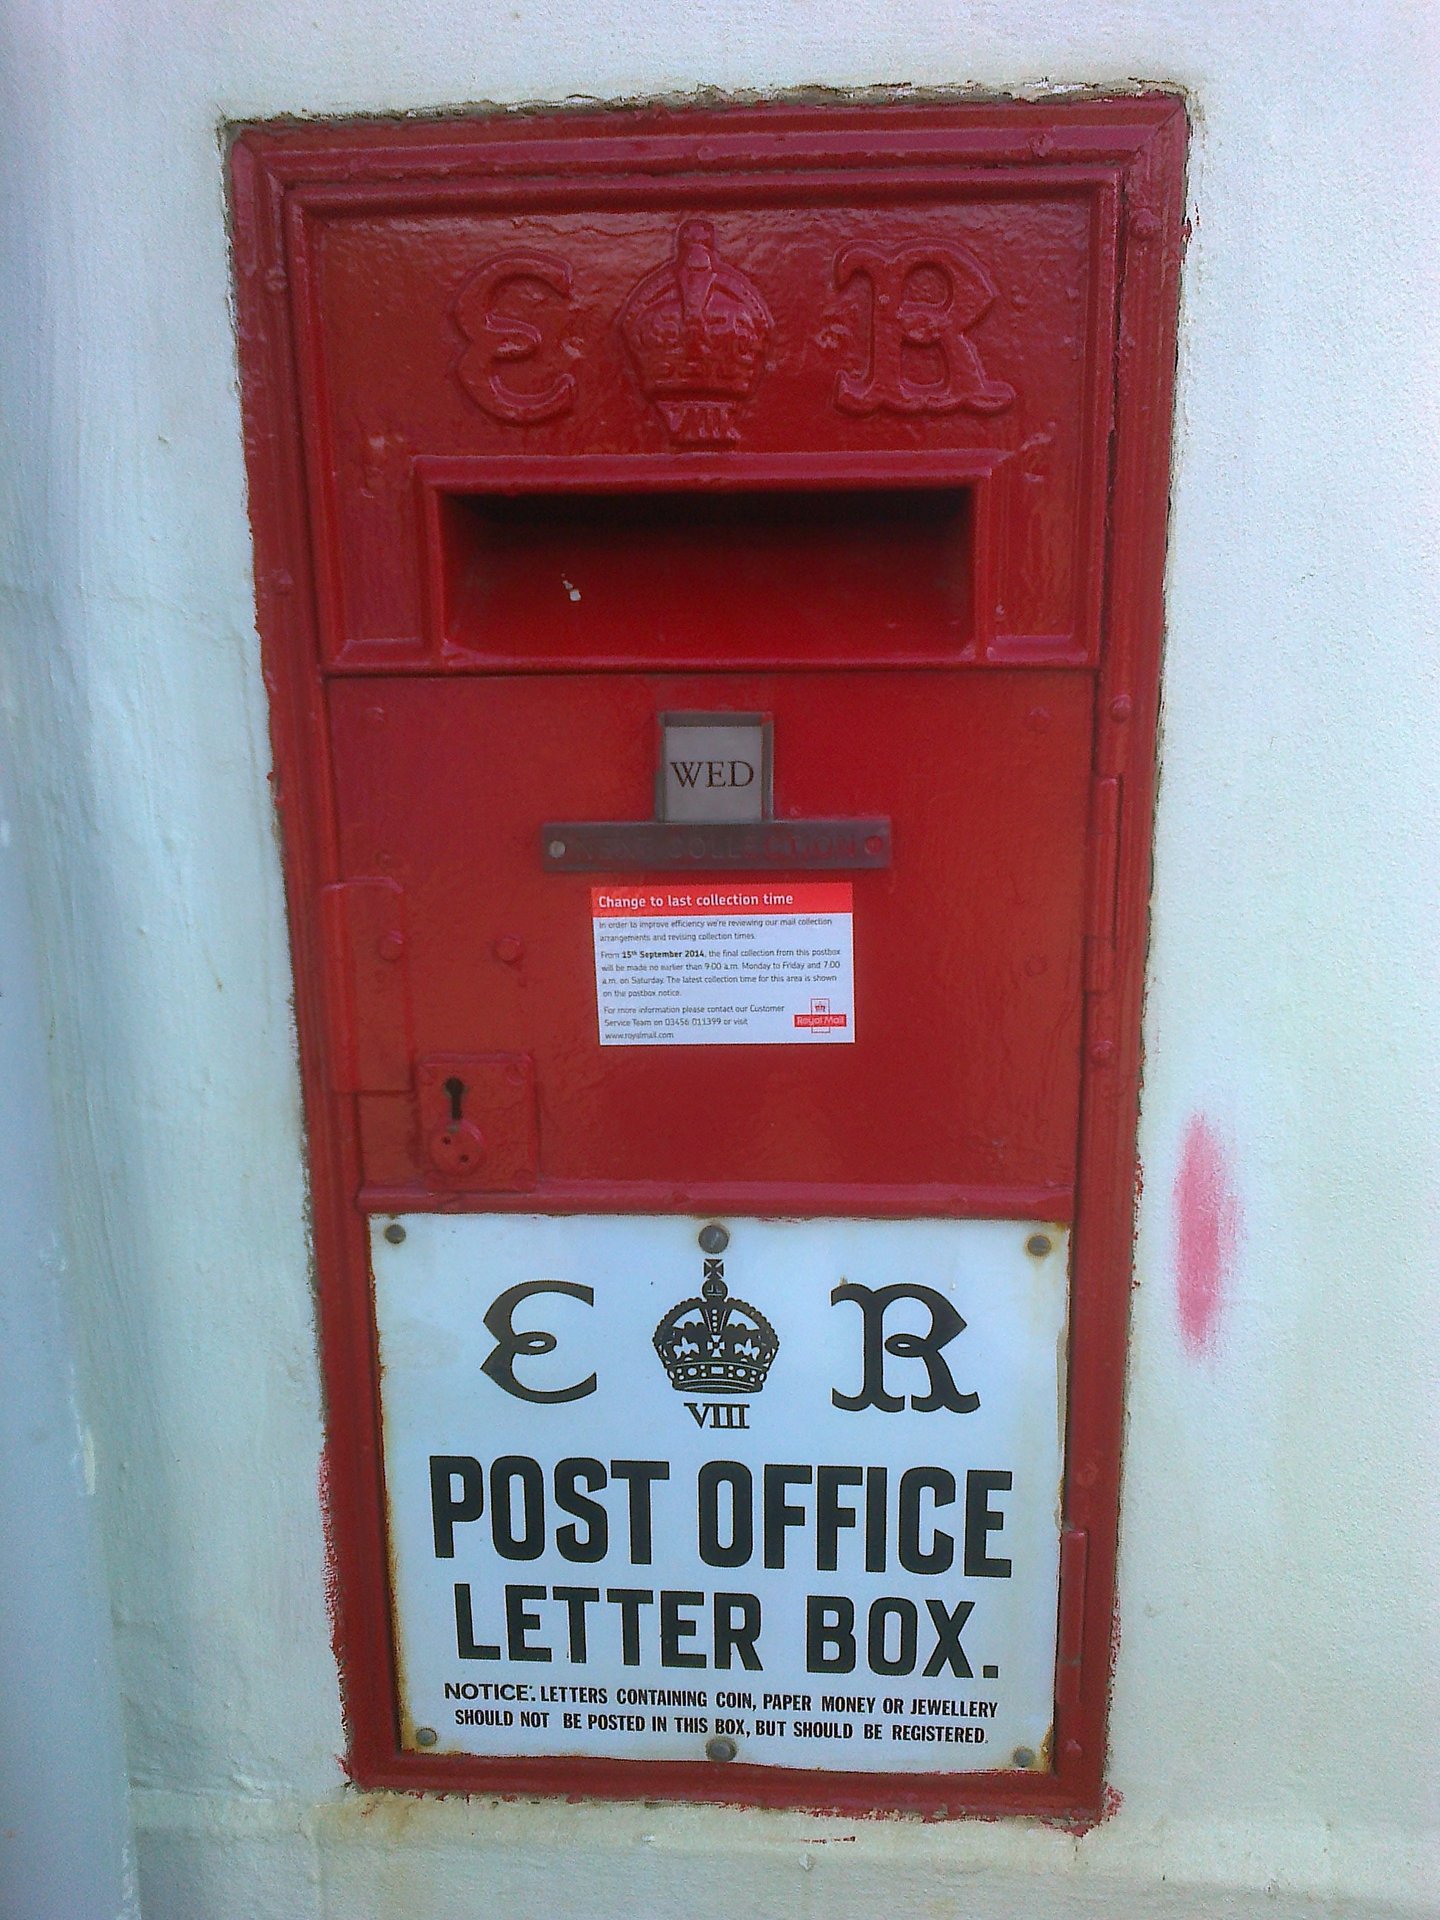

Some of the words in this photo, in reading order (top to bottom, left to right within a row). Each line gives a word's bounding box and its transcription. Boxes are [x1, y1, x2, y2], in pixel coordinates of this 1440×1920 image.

[451, 247, 574, 422] E
[833, 237, 1014, 416] R
[670, 761, 754, 788] WED
[598, 895, 646, 910] Change
[650, 896, 663, 907] to
[668, 895, 691, 907] last
[696, 893, 759, 906] collection
[763, 892, 793, 905] time
[608, 920, 627, 929] order
[630, 921, 637, 929] to
[640, 920, 669, 930] improve
[671, 919, 705, 929] efficiency
[728, 918, 763, 928] reviewing
[780, 918, 796, 926] mail
[798, 917, 832, 926] collection
[600, 934, 650, 943] arrangements
[653, 933, 666, 941] and
[668, 933, 697, 942] revising
[698, 932, 732, 941] collection
[601, 951, 619, 959] From
[640, 950, 682, 960] September
[708, 950, 720, 958] the
[722, 949, 738, 957] final
[741, 949, 774, 957] collection
[776, 949, 793, 957] from
[796, 948, 809, 956] this
[812, 948, 840, 957] postbox
[602, 964, 613, 972] will
[615, 964, 624, 972] be
[627, 963, 647, 972] made
[661, 963, 684, 971] earlier
[685, 962, 702, 971] than
[742, 961, 771, 971] Monday
[782, 961, 805, 970] Friday
[807, 961, 820, 969] and
[666, 975, 680, 984] The
[682, 975, 702, 984] latest
[704, 974, 738, 983] collection
[740, 975, 756, 983] time
[758, 974, 769, 982] for
[770, 974, 784, 982] this
[786, 974, 802, 982] area
[805, 974, 810, 982] is
[813, 973, 837, 982] shown
[603, 989, 612, 997] on
[614, 989, 626, 997] the
[628, 989, 656, 998] postbox
[604, 1006, 616, 1014] For
[618, 1006, 636, 1014] more
[638, 1005, 680, 1013] information
[682, 1005, 705, 1014] please
[707, 1005, 733, 1013] contact
[750, 1004, 784, 1012] Customer
[604, 1018, 630, 1027] Service
[632, 1018, 652, 1026] Team
[654, 1018, 663, 1026] on
[734, 1017, 748, 1025] visit
[796, 1016, 823, 1026] Royal
[824, 1015, 844, 1025] Mail
[480, 1280, 597, 1404] E
[831, 1282, 980, 1414] R
[684, 1402, 750, 1429] VIII
[429, 1455, 669, 1565] POST
[698, 1461, 1012, 1578] OFFICE
[453, 1583, 764, 1671] LETTER
[806, 1595, 999, 1679] BOX.
[540, 1686, 608, 1704] LETTERS
[617, 1688, 708, 1708] CONTAINING
[715, 1691, 757, 1711] COIN,
[763, 1694, 811, 1711] PAPER
[821, 1696, 876, 1714] MONEY
[882, 1697, 904, 1714] OR
[910, 1699, 998, 1718] JEWELLERY
[455, 1709, 513, 1726] SHOULD
[521, 1712, 549, 1728] NOT
[563, 1713, 582, 1729] BE
[588, 1714, 645, 1731] POSTED
[652, 1716, 667, 1732] IN
[674, 1717, 708, 1733] THIS
[715, 1718, 750, 1738] BOX,
[755, 1720, 786, 1736] BUT
[793, 1721, 853, 1739] SHOULD
[864, 1724, 883, 1740] BE
